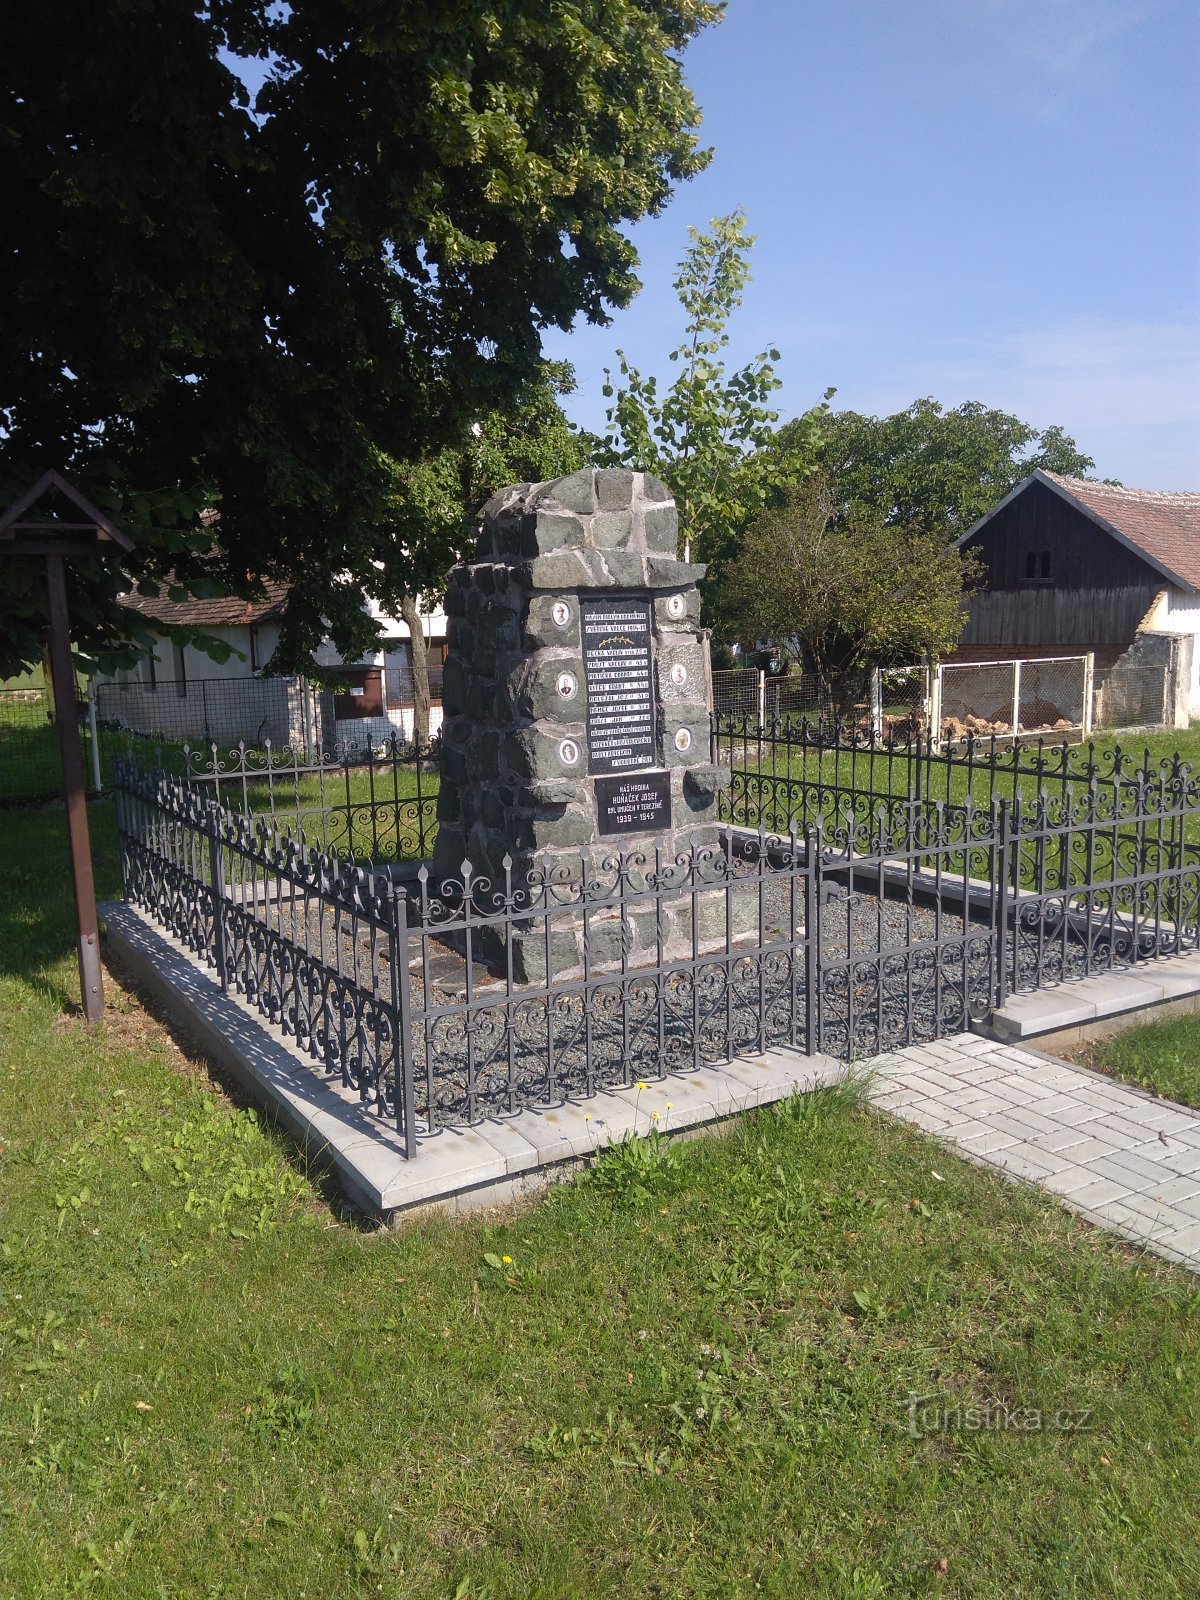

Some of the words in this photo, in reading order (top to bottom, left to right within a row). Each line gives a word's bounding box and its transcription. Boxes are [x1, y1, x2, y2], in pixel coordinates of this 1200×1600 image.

[620, 784, 630, 792] NÁŠ
[630, 784, 649, 792] HRDINA
[612, 793, 639, 804] HUŇÁČEK
[640, 792, 658, 801] JOSEF
[617, 804, 636, 813] UMUČEN
[616, 814, 632, 823] 1939
[640, 812, 654, 821] 1945
